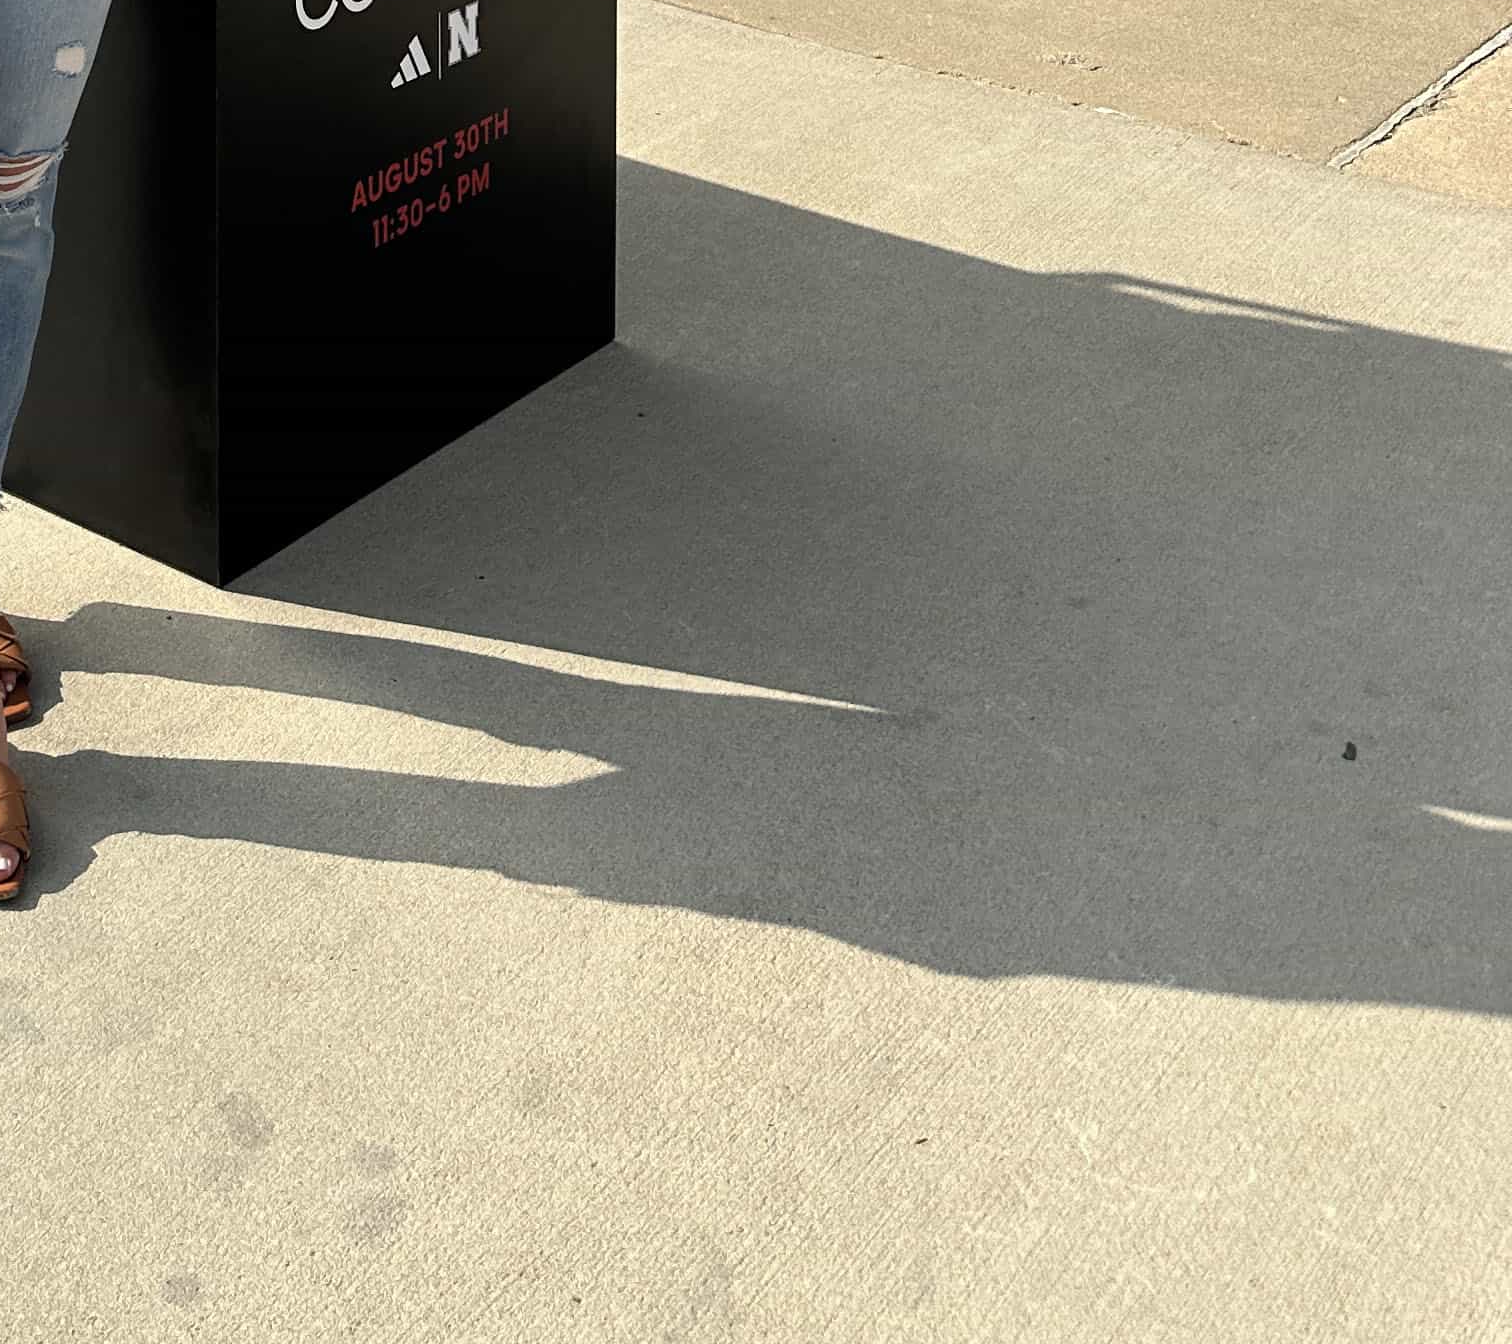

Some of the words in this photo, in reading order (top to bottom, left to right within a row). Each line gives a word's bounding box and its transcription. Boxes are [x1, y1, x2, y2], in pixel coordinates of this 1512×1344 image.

[447, 0, 482, 67] N
[351, 138, 447, 214] AUGUST
[454, 108, 510, 161] 30TH
[456, 161, 491, 210] PM
